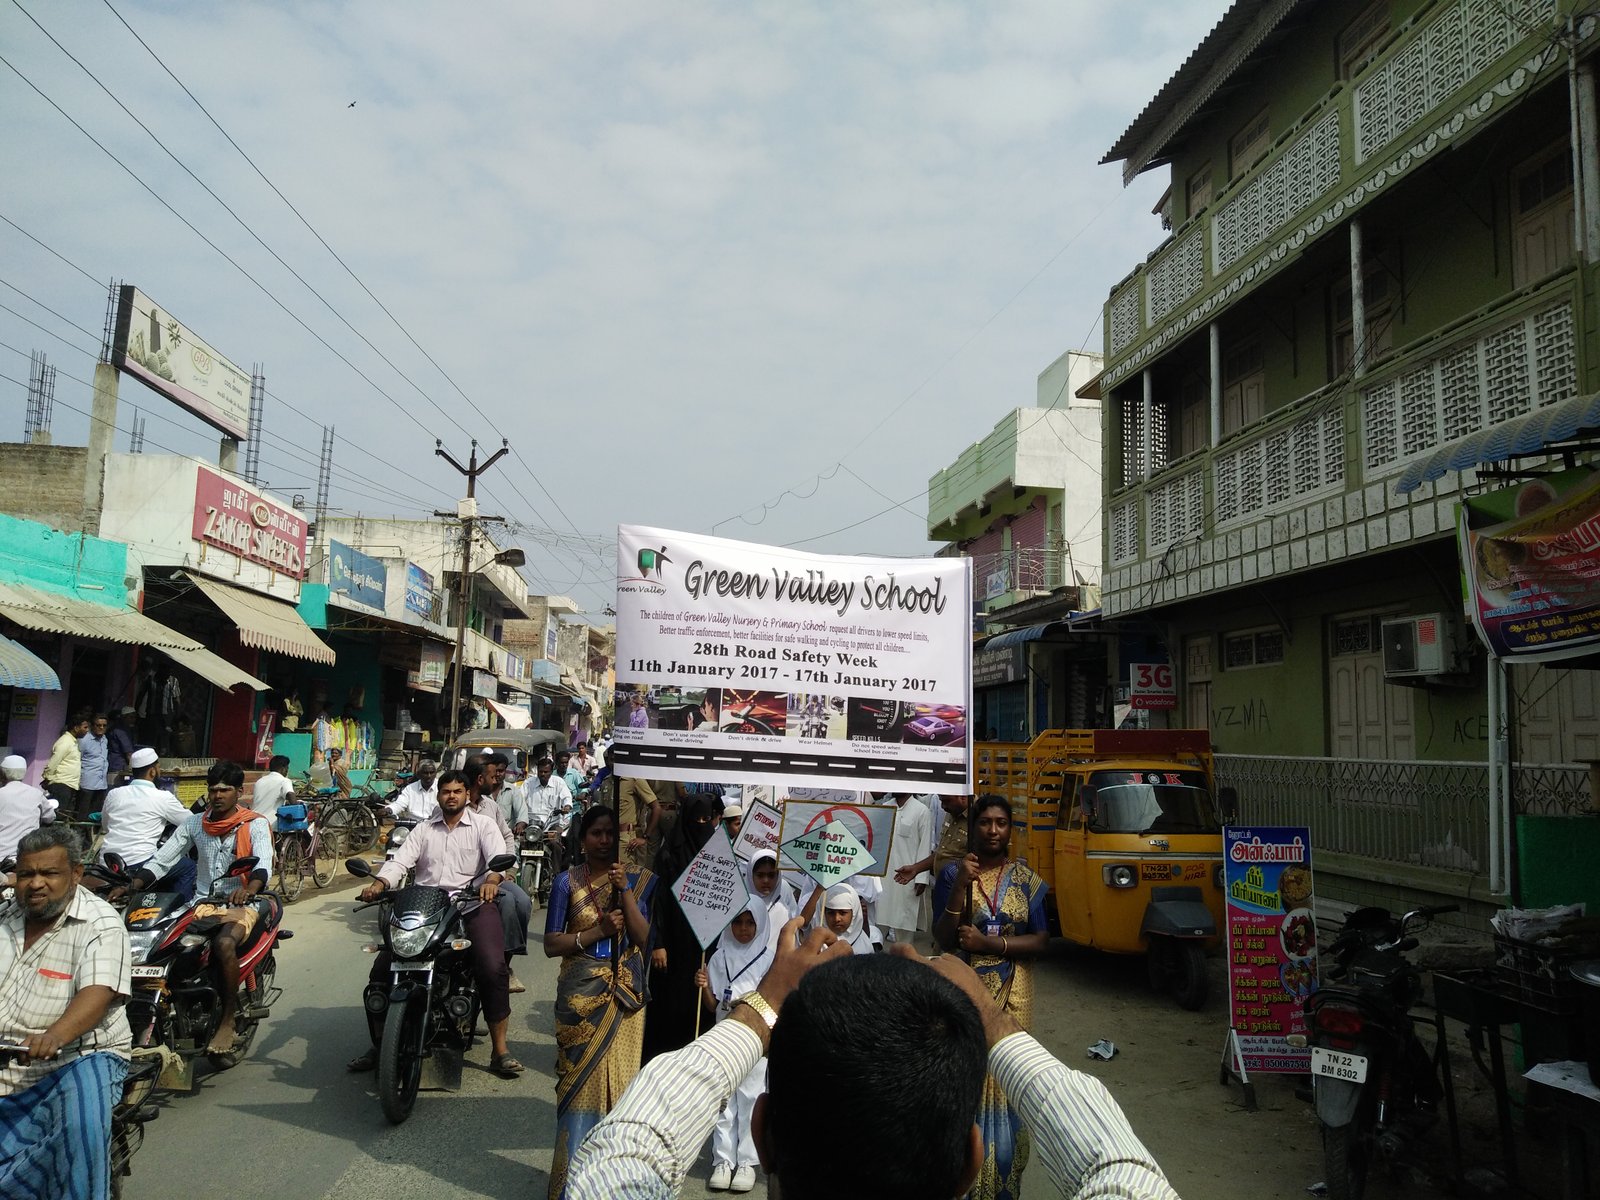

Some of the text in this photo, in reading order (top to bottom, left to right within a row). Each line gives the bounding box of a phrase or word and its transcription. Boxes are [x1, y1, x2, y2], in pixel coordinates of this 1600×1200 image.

[204, 505, 302, 573] ZAKIR SWEETS
[639, 586, 666, 595] Valley
[685, 560, 769, 600] Green
[772, 567, 855, 617] Valley
[860, 573, 947, 615] School
[640, 610, 650, 619] The
[652, 610, 674, 620] children
[676, 611, 683, 620] of
[684, 612, 707, 622] Green
[708, 612, 731, 627] Valley
[733, 614, 761, 629] Nursery
[763, 617, 769, 627] &
[771, 618, 800, 632] Primary
[802, 620, 826, 632] School
[829, 626, 848, 634] request
[857, 626, 875, 636] drivers
[876, 628, 882, 636] to
[882, 629, 897, 638] lower
[898, 630, 912, 641] speed
[660, 625, 676, 635] Better
[678, 627, 695, 635] traffic
[696, 628, 732, 639] enforcement,
[733, 629, 749, 640] better
[750, 630, 774, 641] facilities
[775, 633, 783, 642] for
[785, 634, 795, 643] safe
[797, 635, 818, 647] walking
[819, 637, 829, 646] and
[830, 638, 849, 648] cycling
[857, 641, 874, 650] protect
[693, 642, 878, 668] 28th Road Safety Week
[630, 659, 662, 672] 11th
[668, 660, 735, 679] January
[741, 665, 778, 679] 2017
[795, 670, 828, 683] 17th
[834, 672, 898, 691] January
[902, 678, 936, 692] 2017
[1137, 665, 1172, 688] 3G
[1127, 773, 1184, 785] J K
[819, 831, 845, 841] FAST
[793, 840, 857, 856] DRIVE COULD
[1231, 836, 1305, 862] அன்ஃபார்
[806, 852, 853, 865] BE LAST
[710, 867, 734, 879] SAFETY
[810, 863, 840, 874] DRIVE
[1185, 863, 1204, 872] FOR
[712, 874, 735, 888] SAFETY
[1184, 871, 1207, 881] HIRE
[683, 885, 732, 905] TEACH SAFETY
[711, 884, 734, 896] SAFETY
[705, 900, 730, 915] SAFETY
[1264, 1060, 1312, 1068] 950067540
[1328, 1054, 1352, 1066] TN 22
[1322, 1065, 1358, 1079] BM 8302
